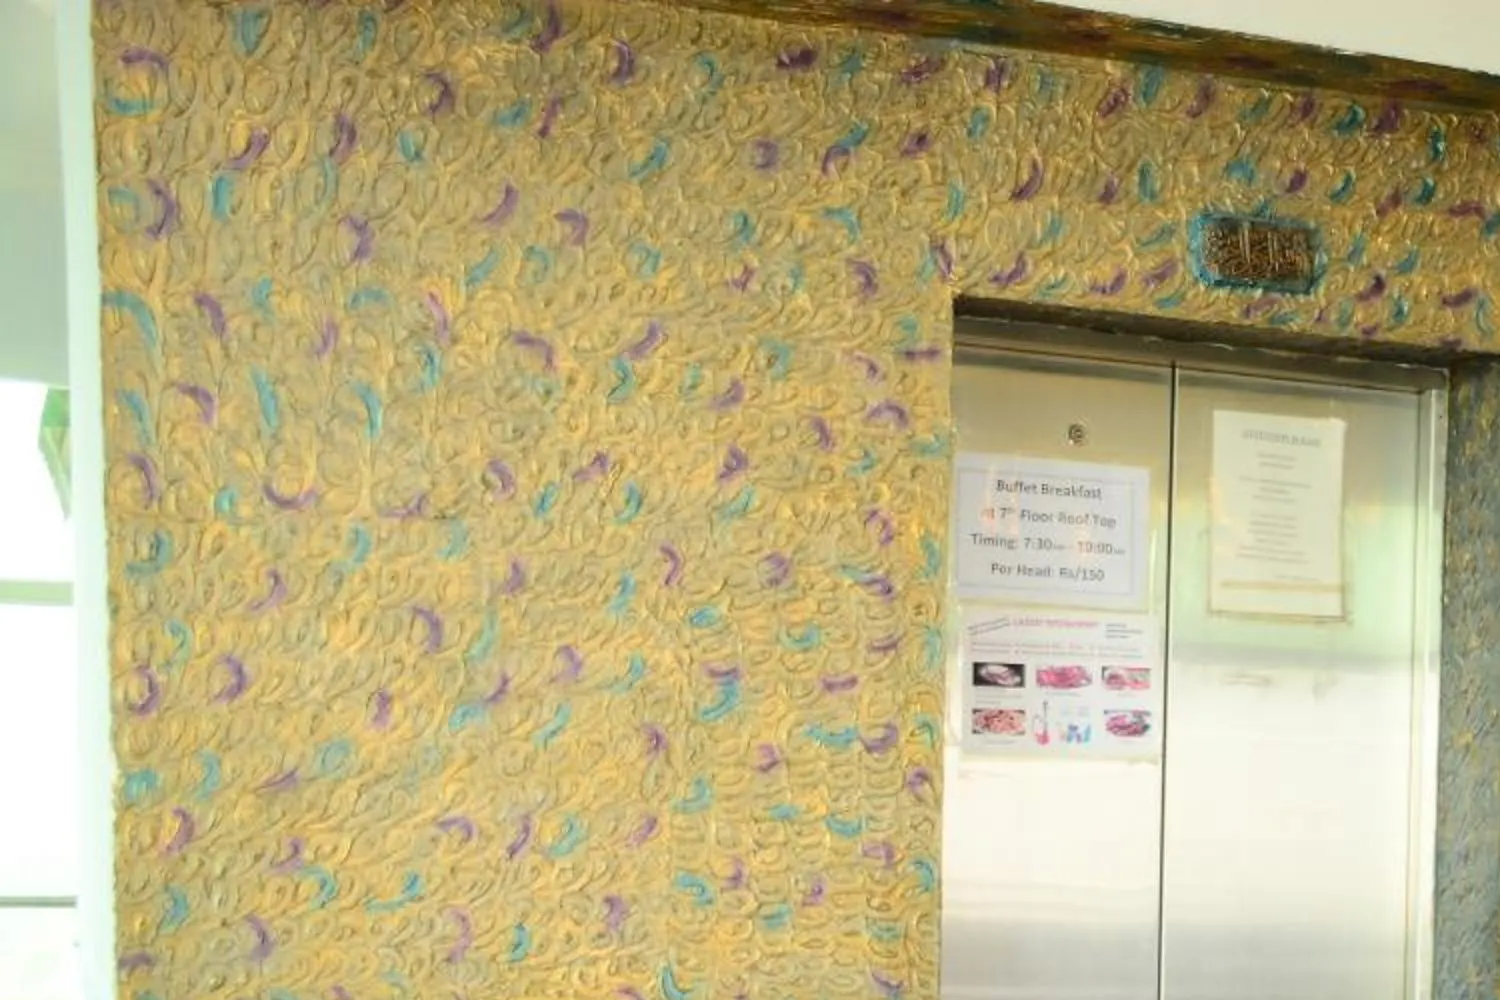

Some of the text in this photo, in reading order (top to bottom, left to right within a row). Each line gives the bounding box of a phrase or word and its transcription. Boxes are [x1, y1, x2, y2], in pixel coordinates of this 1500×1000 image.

[996, 479, 1103, 501] Buffet Breakfast
[1020, 509, 1054, 524] Floor
[1057, 512, 1090, 526] Roof
[1092, 514, 1117, 529] Top
[970, 533, 1019, 550] Timing:
